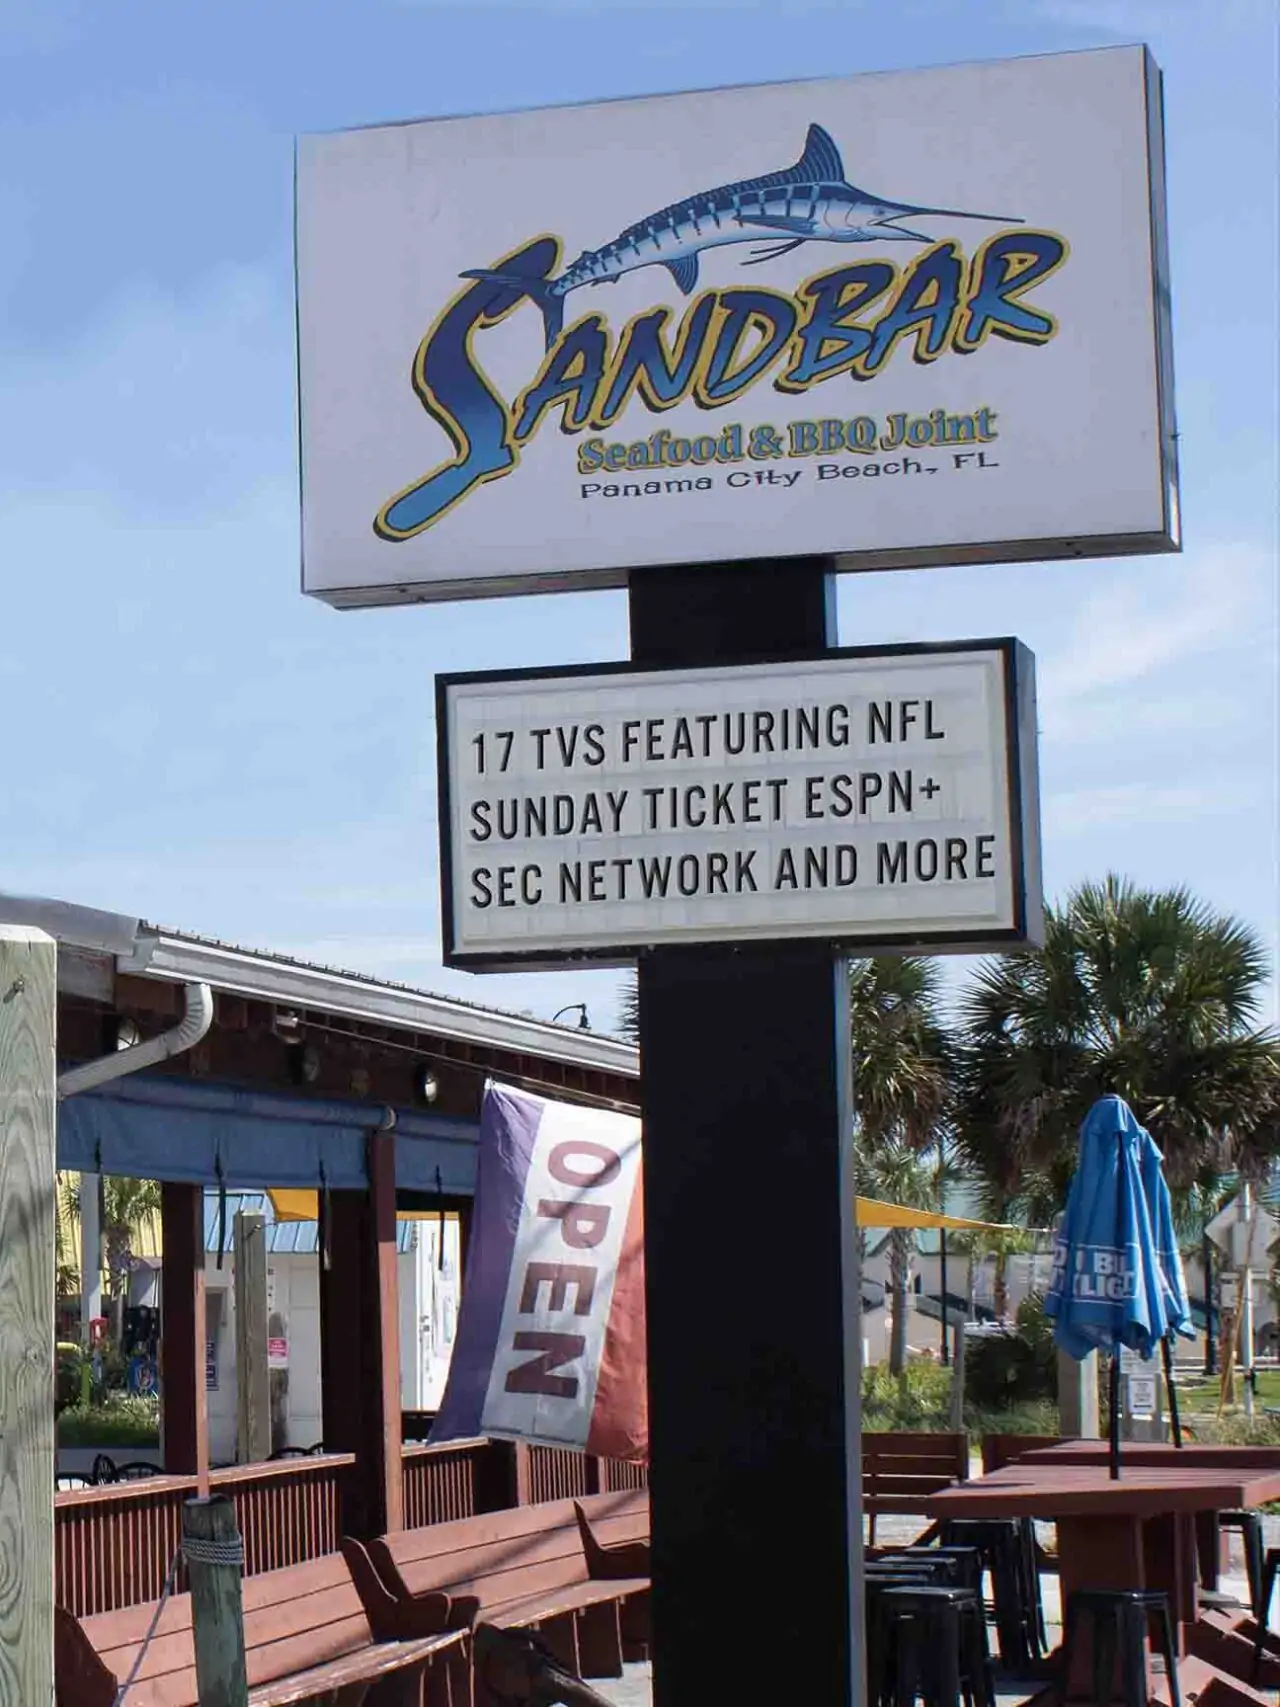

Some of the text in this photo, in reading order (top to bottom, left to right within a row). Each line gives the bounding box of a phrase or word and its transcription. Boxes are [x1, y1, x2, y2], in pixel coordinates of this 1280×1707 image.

[373, 229, 1069, 542] SANDBAR
[577, 407, 999, 475] Seafood & BBQ Joint
[581, 450, 1000, 499] Panama City Beach, FL
[471, 699, 945, 774] 17 TVS FEATURING NFL
[471, 769, 941, 841] SUNDAY TICKET ESPN+
[471, 834, 997, 909] SEC NETWORK AND MORE
[505, 1139, 623, 1401] OPEN
